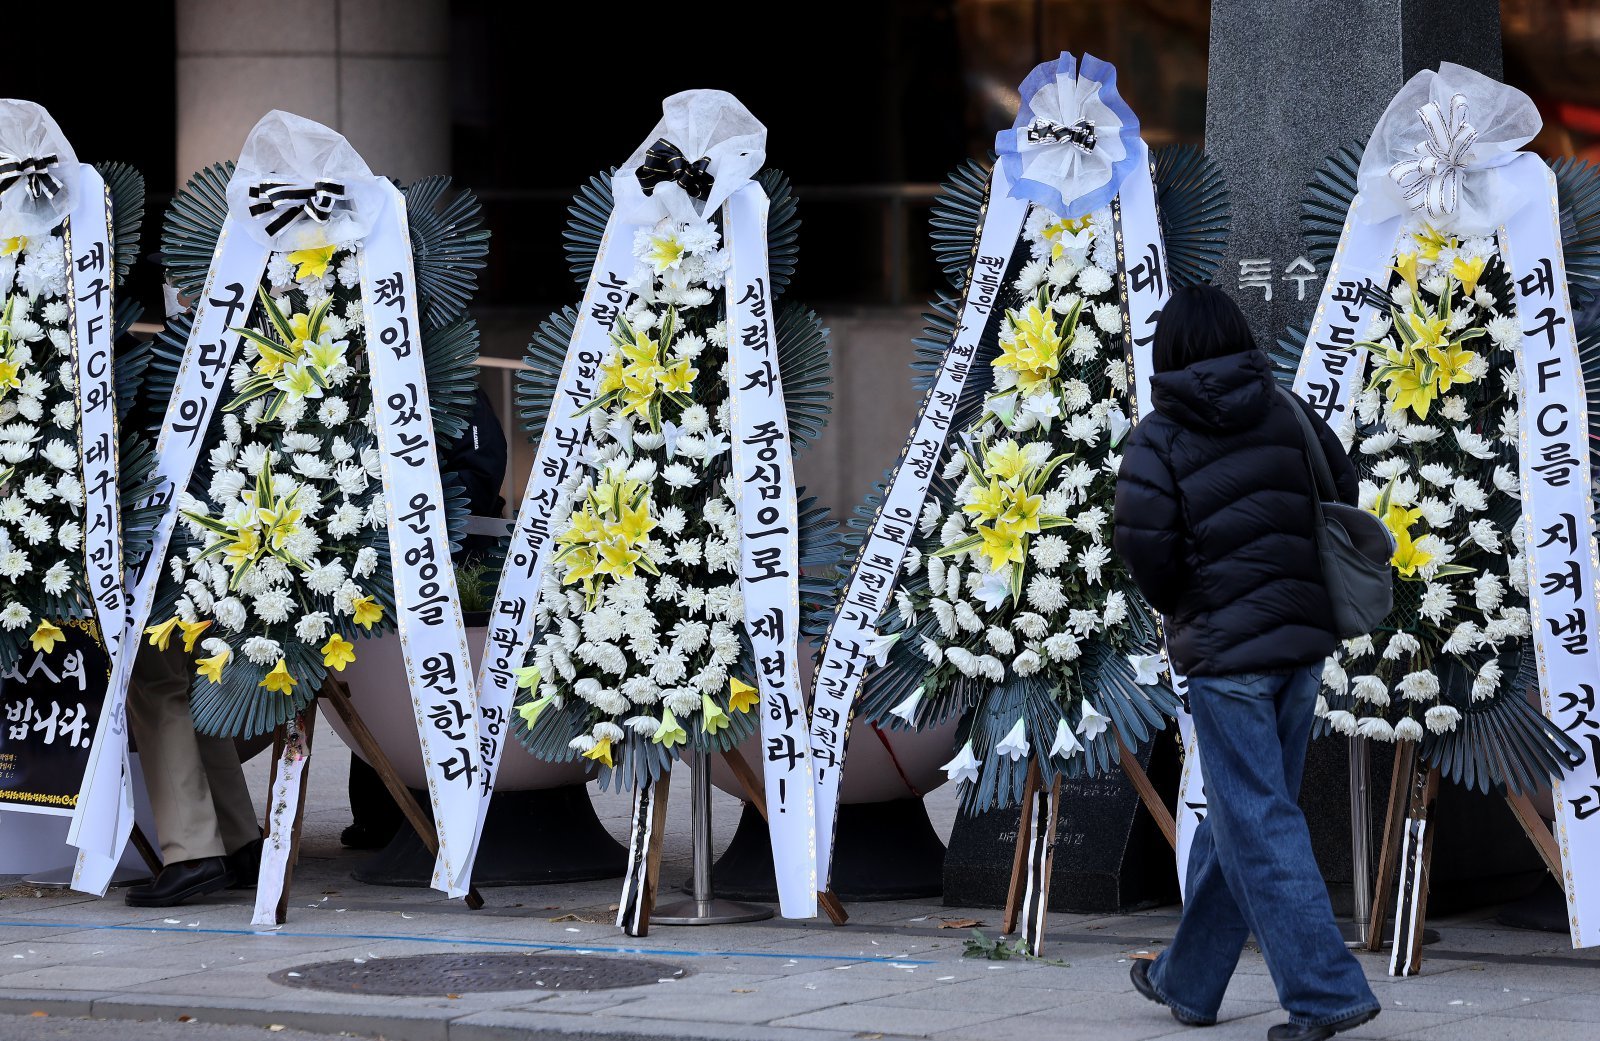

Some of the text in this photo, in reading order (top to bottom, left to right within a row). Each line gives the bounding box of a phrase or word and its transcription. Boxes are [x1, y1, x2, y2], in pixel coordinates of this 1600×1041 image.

[75, 242, 112, 413] 대구FC와
[590, 271, 628, 335] 능력
[969, 255, 1004, 315] 팬들은
[172, 282, 245, 449] 구단의
[565, 351, 603, 409] 없는
[1517, 258, 1580, 487] 대구FC를
[84, 432, 120, 611] 대구시민을
[373, 271, 478, 789] 책임 있는 운영을 원한다
[737, 278, 804, 814] 실력자 중심으로 재편하라!
[842, 554, 894, 631] 프런트가
[1536, 513, 1589, 655] 지켜낼
[487, 597, 527, 690] 대팍을
[820, 638, 868, 701] 나가길
[5, 697, 91, 748] 빕니다.
[811, 706, 841, 785] 외친다!
